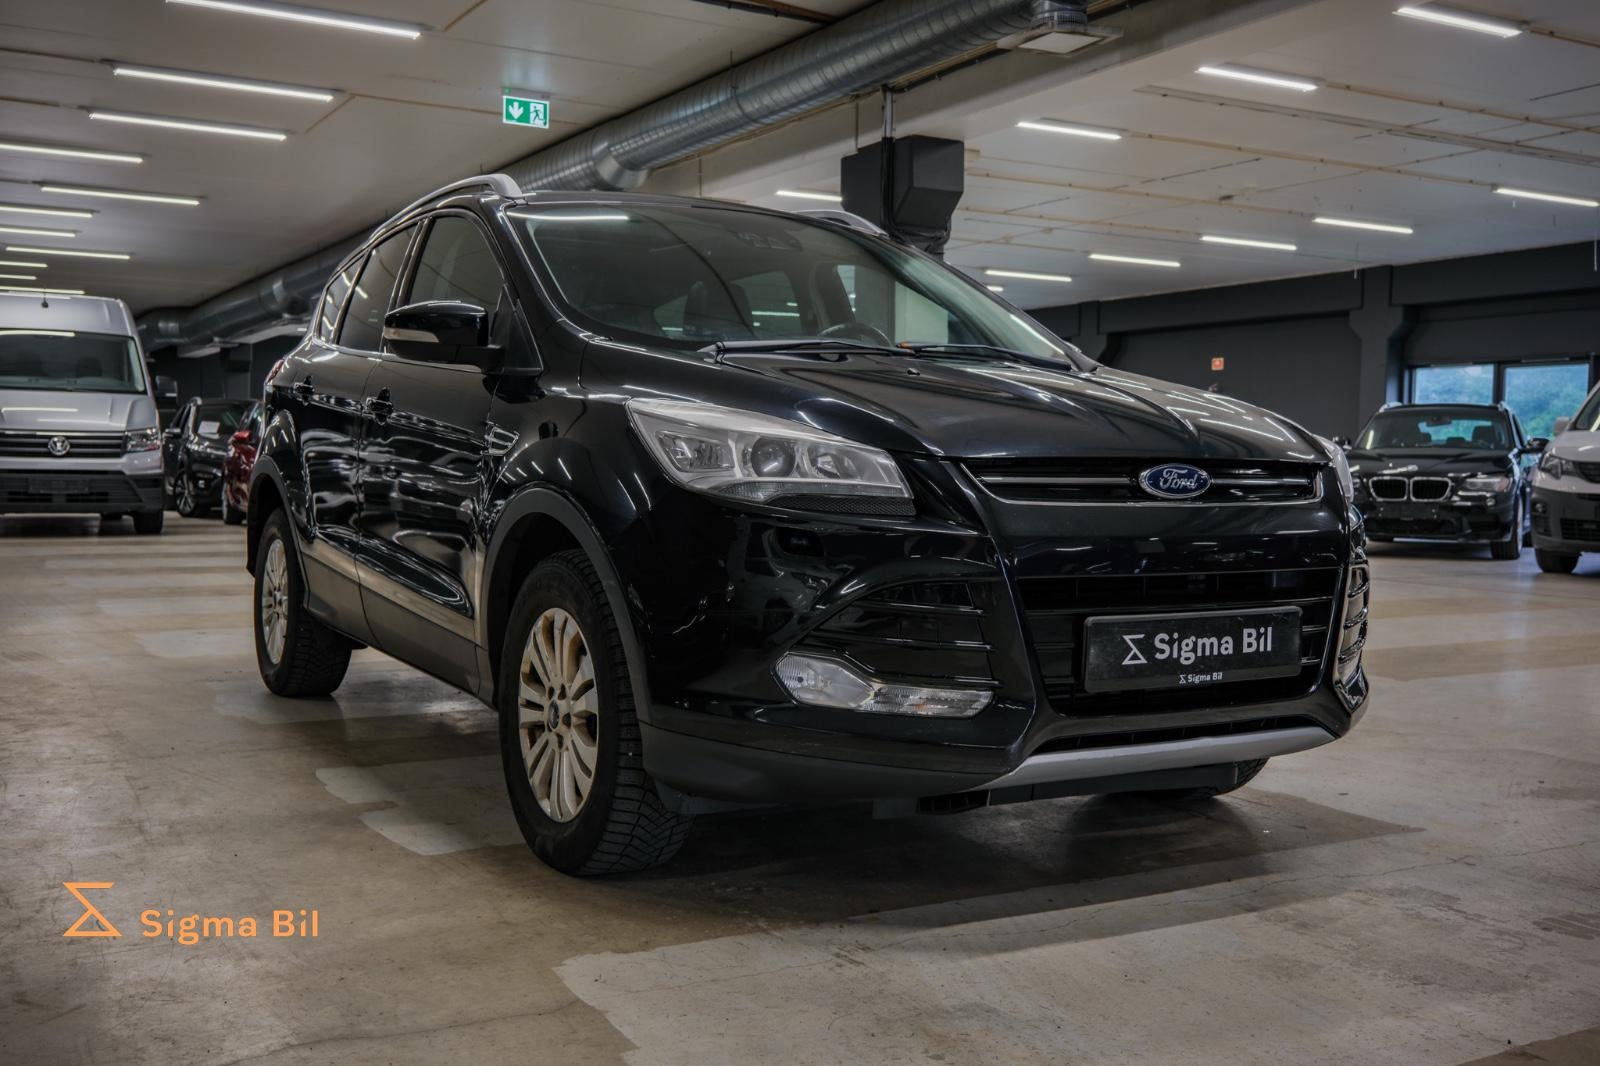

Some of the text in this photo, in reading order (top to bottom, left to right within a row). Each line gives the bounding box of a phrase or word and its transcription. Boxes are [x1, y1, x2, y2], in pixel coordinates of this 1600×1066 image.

[1160, 468, 1198, 490] Ford
[1154, 626, 1273, 665] Sigma Bil
[1187, 671, 1223, 684] Sigma Bil
